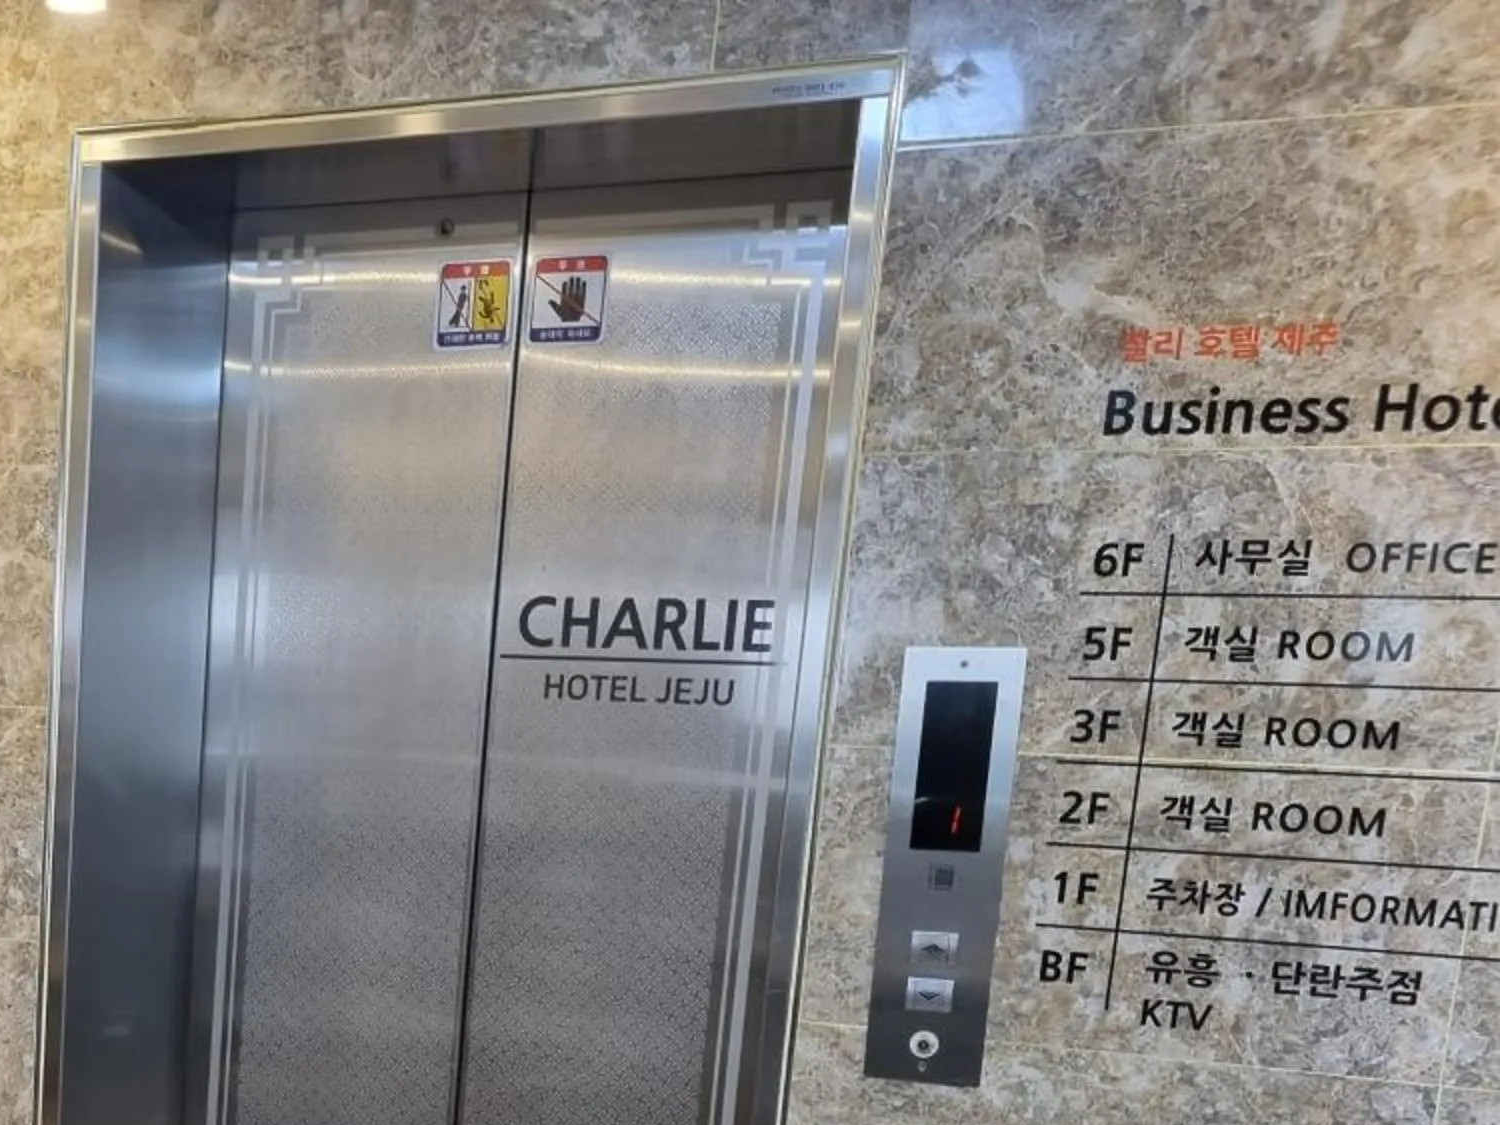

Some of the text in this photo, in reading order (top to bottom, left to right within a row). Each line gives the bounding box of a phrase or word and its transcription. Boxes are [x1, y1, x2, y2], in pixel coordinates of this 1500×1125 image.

[1194, 323, 1261, 361] 호텔
[1271, 319, 1341, 357] 제주
[1103, 382, 1500, 436] Business Hot
[1092, 541, 1145, 577] 6F
[1195, 538, 1498, 577] 사무실 OFFICE
[519, 595, 775, 652] CHARLIE
[1083, 626, 1132, 661] 5F
[1184, 625, 1415, 662] 객실 ROOM
[543, 673, 735, 706] HOTEL JEJU
[1070, 709, 1121, 744] 3F
[1172, 711, 1401, 751] 객실 ROOM
[1058, 791, 1110, 825] 2F
[1160, 795, 1387, 838] 객실 ROOM
[1053, 871, 1099, 904] 1F
[1146, 878, 1246, 917] 주차장
[1284, 889, 1498, 933] IMFORMATI
[1039, 950, 1088, 984] BF
[1145, 951, 1221, 988] 유흥
[1271, 961, 1424, 1006] 단란주점
[1140, 999, 1213, 1031] KTV
